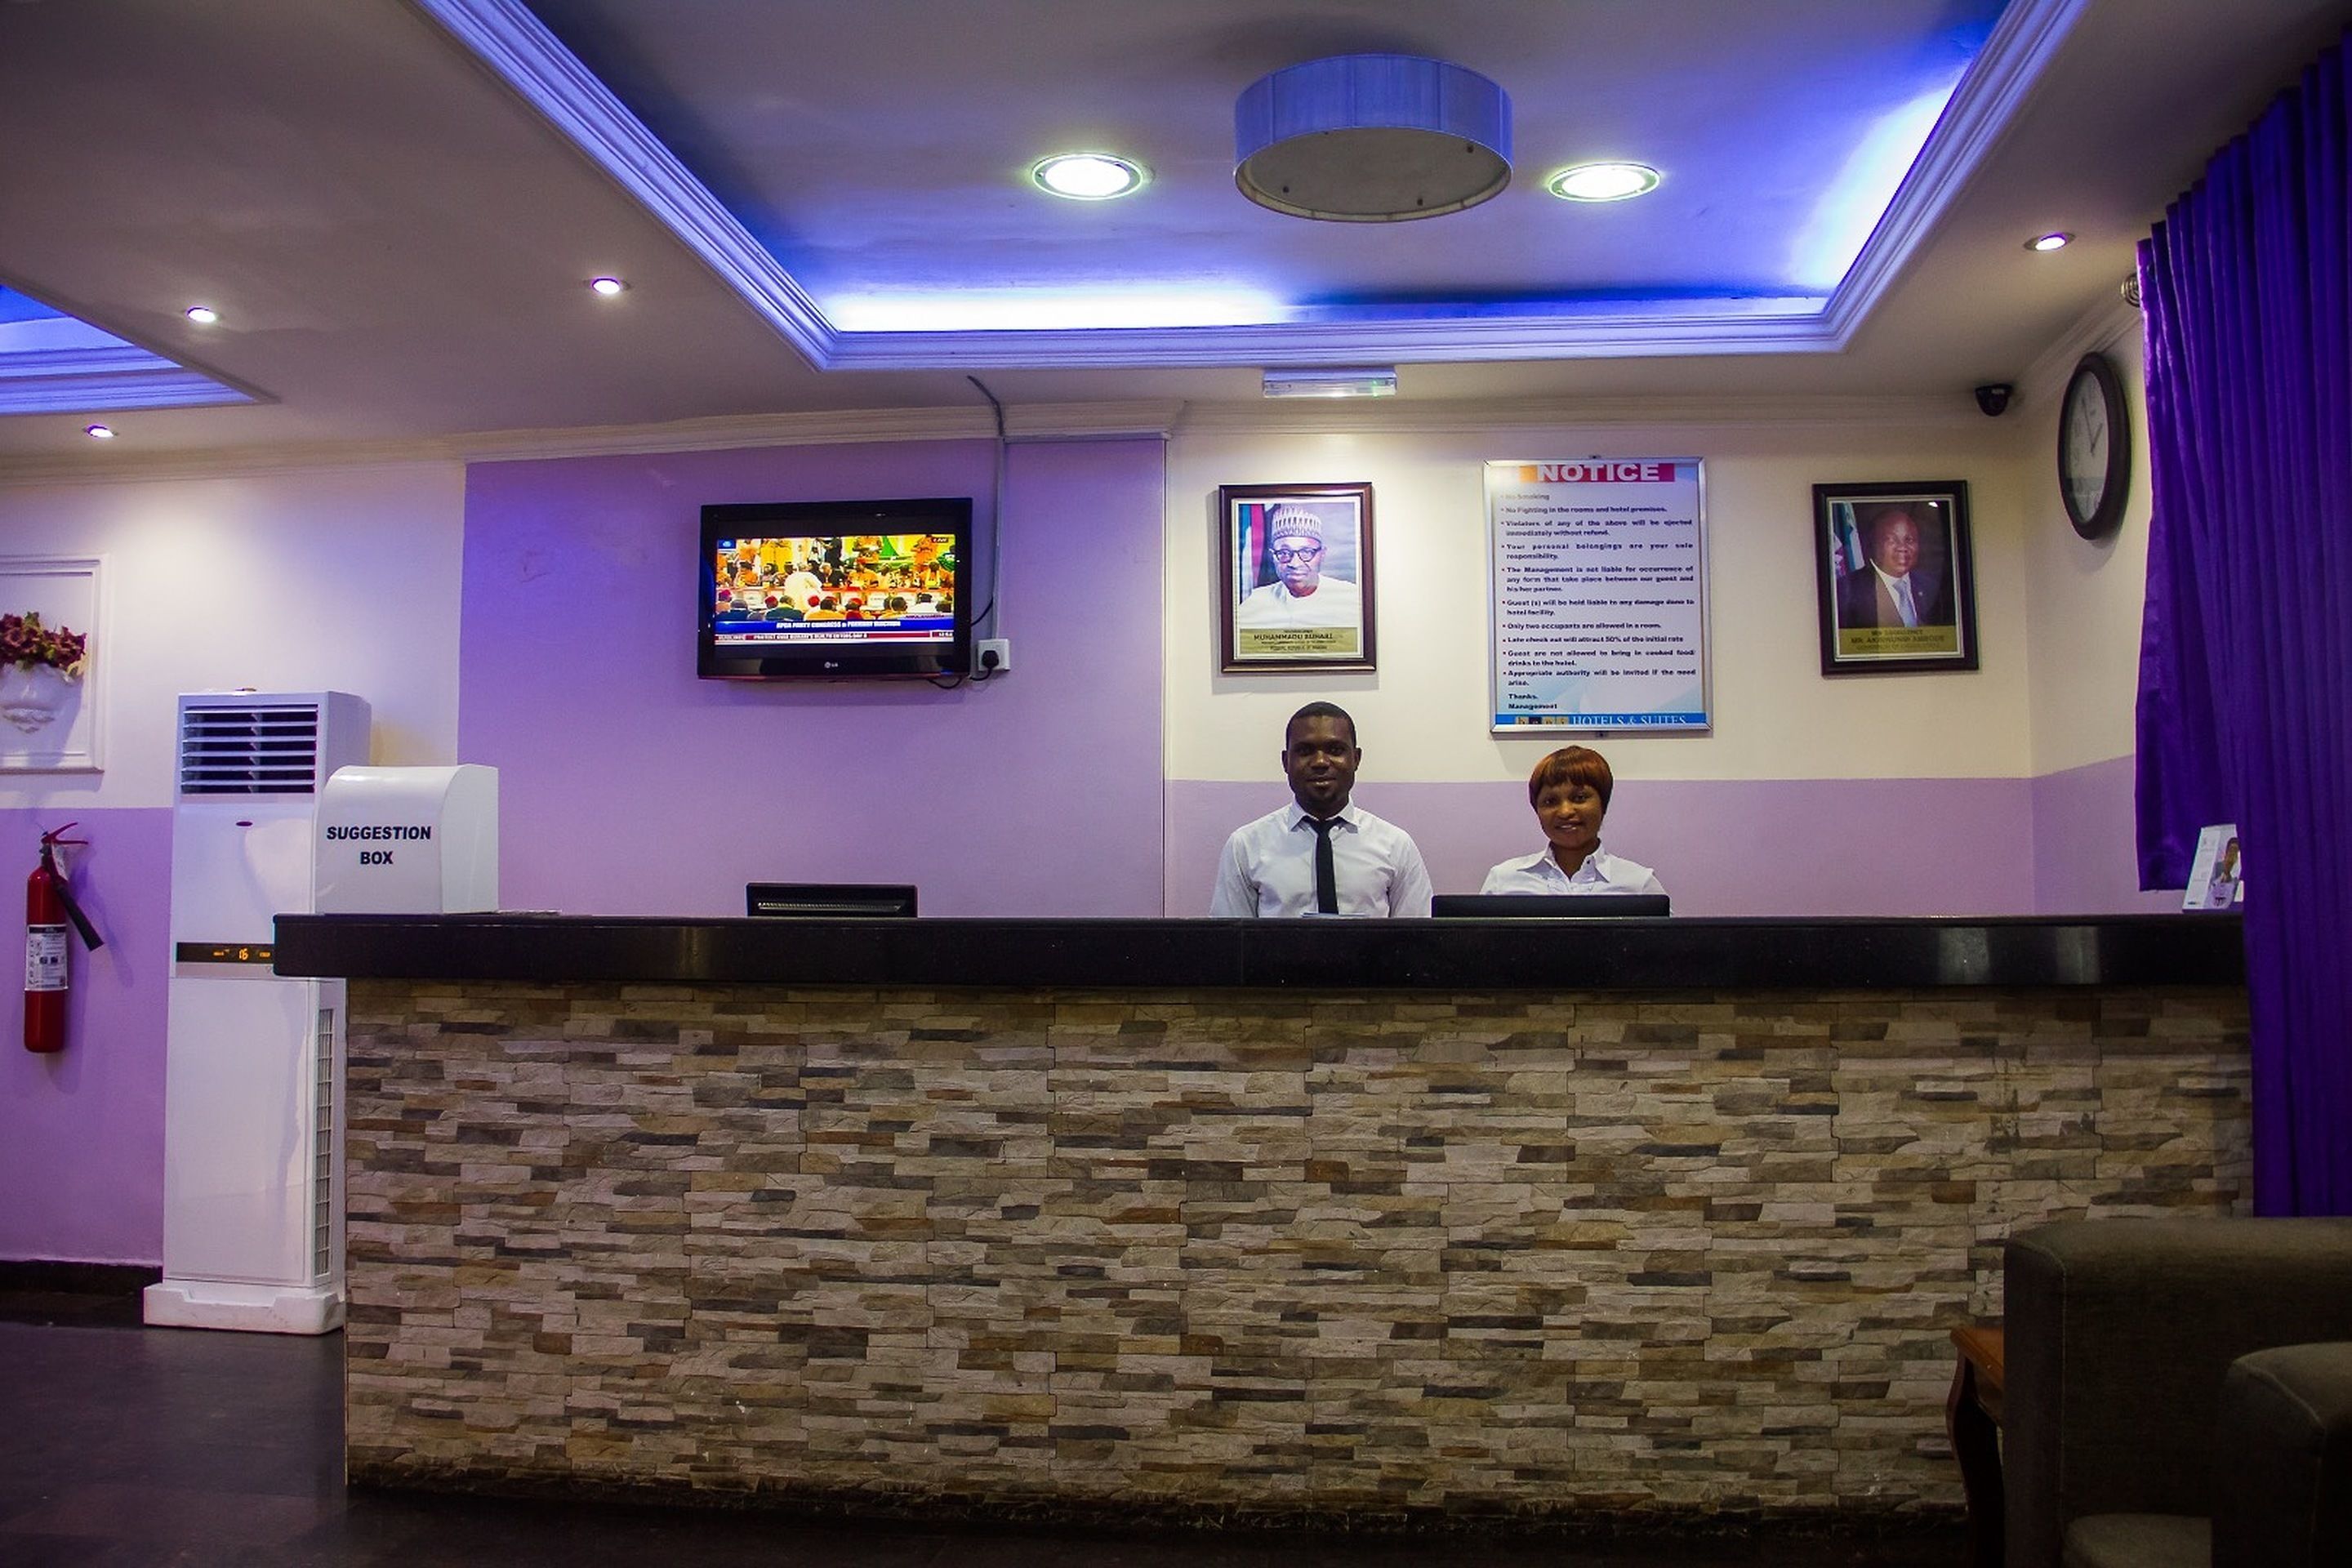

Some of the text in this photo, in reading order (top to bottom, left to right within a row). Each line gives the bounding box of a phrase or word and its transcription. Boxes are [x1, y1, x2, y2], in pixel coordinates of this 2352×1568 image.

[1537, 463, 1660, 482] NOTICE
[1576, 542, 1622, 550] belongings
[1573, 715, 1624, 724] HOTELS
[1641, 715, 1686, 724] SUITES
[327, 826, 432, 840] SUGGESTION
[360, 851, 394, 864] BOX
